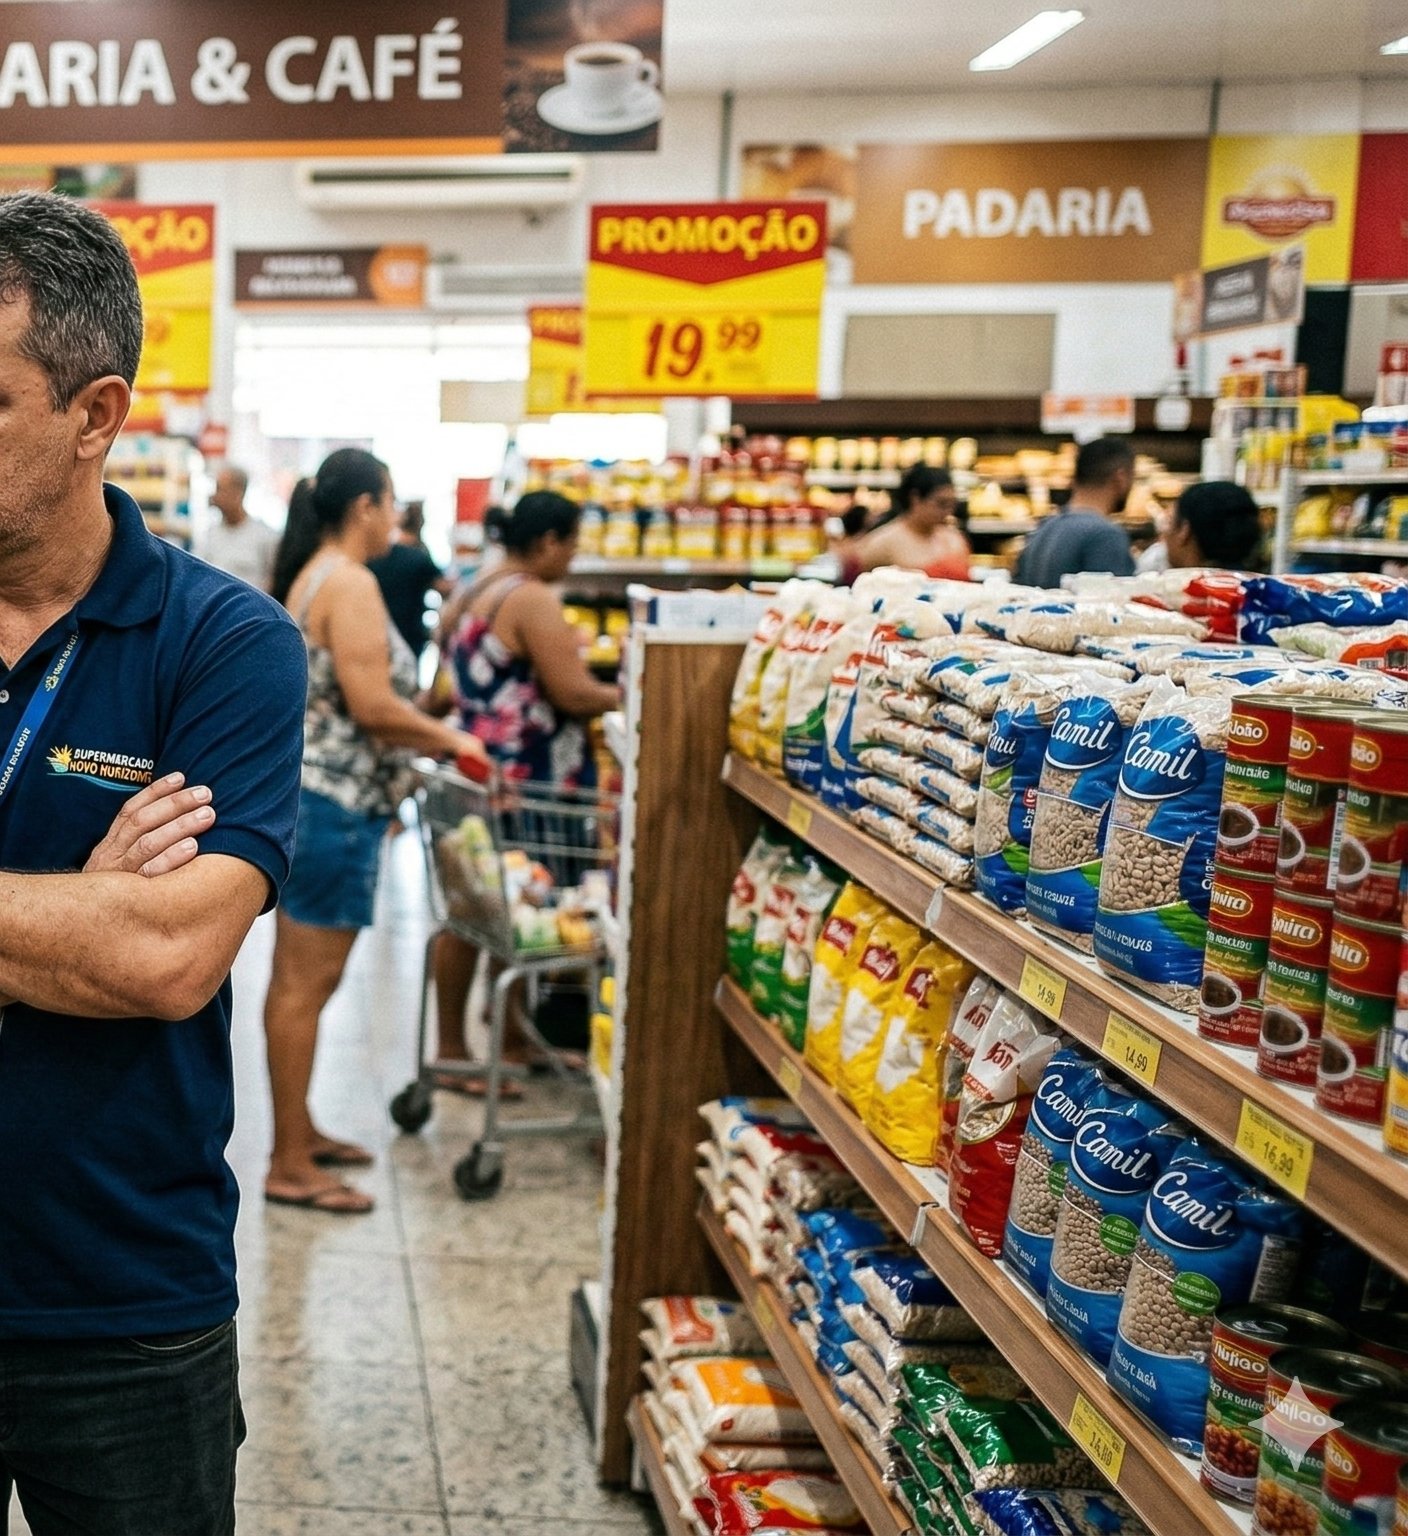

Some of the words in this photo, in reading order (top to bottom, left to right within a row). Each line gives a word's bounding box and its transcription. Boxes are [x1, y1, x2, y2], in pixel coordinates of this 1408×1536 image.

[190, 36, 252, 104] &
[264, 17, 463, 102] CAFÉ
[598, 208, 820, 261] PROMOÇÃO
[903, 186, 1154, 239] PADARIA
[1051, 707, 1115, 751] Camil
[1124, 731, 1198, 780] Camil
[1076, 1121, 1152, 1180] Camil
[1152, 1171, 1233, 1236] Camil
